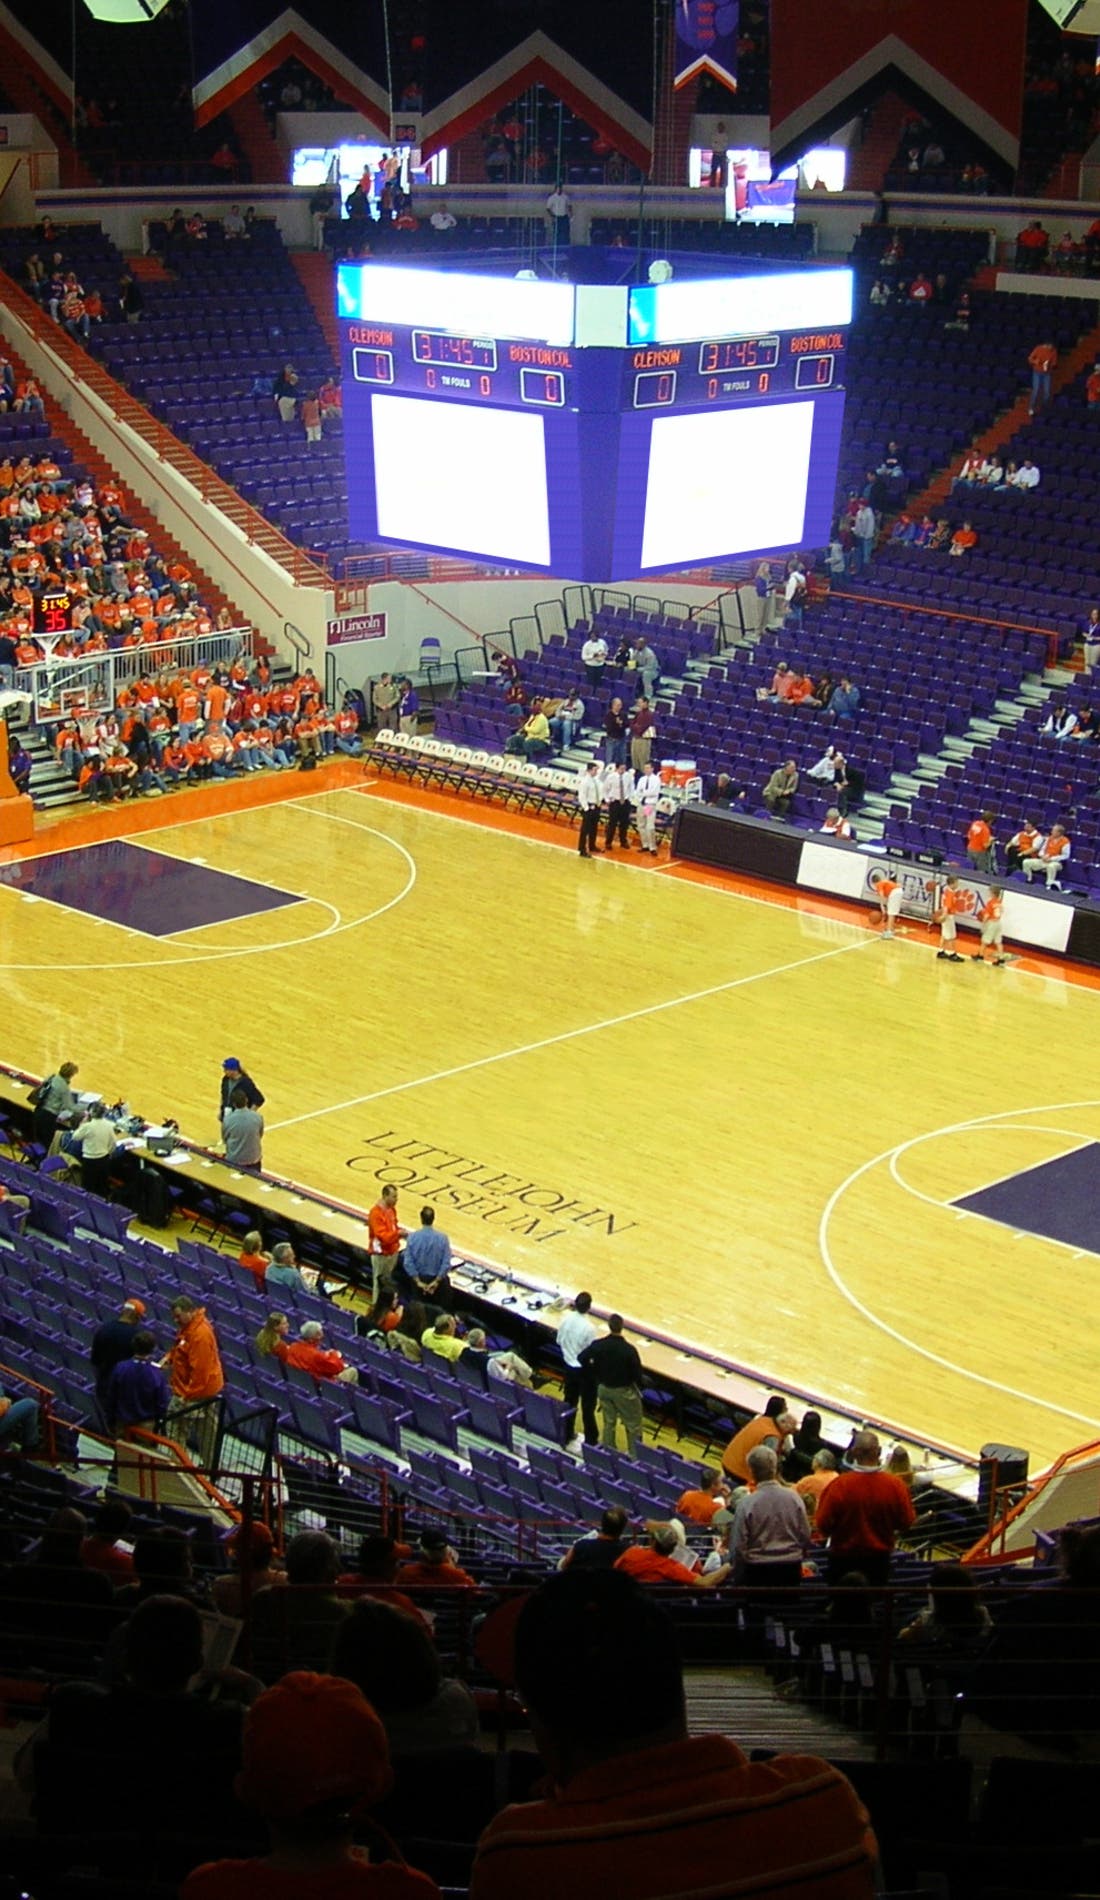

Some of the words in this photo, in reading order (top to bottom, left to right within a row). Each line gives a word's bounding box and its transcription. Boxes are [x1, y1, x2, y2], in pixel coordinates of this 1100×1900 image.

[349, 327, 393, 347] CLEMSON
[420, 334, 473, 364] 31:45
[634, 348, 681, 369] CLEMSON
[376, 355, 387, 379] 0
[426, 369, 436, 388] 0
[816, 359, 829, 383] 0
[480, 375, 491, 395] 0
[545, 374, 558, 402] 0
[657, 375, 670, 401] 0
[708, 378, 718, 399] 0
[759, 373, 769, 393] 0
[45, 609, 66, 632] 35
[342, 616, 380, 632] Lincoln
[363, 1131, 639, 1237] LITTLEJOHN
[345, 1155, 566, 1242] COLISEUM
